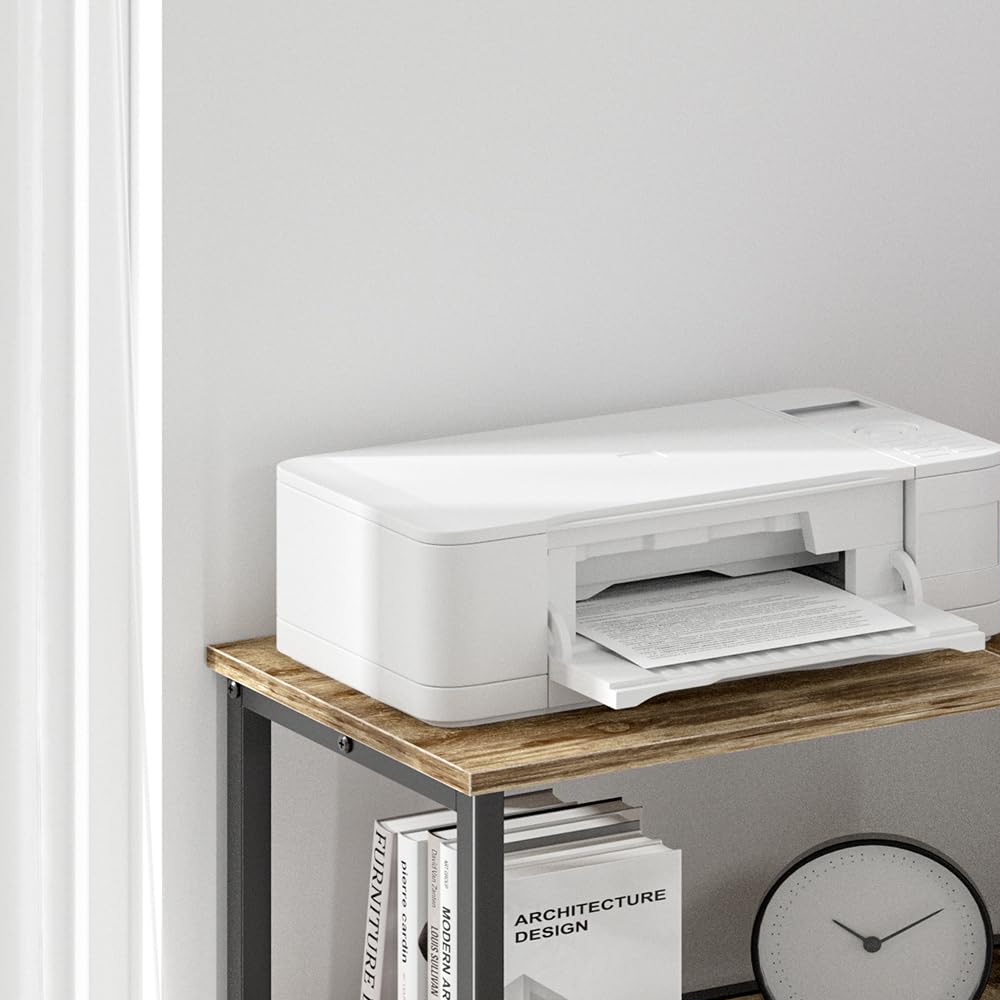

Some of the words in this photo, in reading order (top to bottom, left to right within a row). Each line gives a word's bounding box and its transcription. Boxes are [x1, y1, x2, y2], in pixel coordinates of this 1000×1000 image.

[400, 860, 408, 907] pierre
[363, 830, 387, 989] FURNITURE
[514, 888, 667, 927] ARCHITECTURE
[430, 926, 439, 953] LOUIS
[442, 905, 452, 976] MODERN
[514, 919, 589, 944] DESIGN
[430, 953, 439, 997] SULLIVAN
